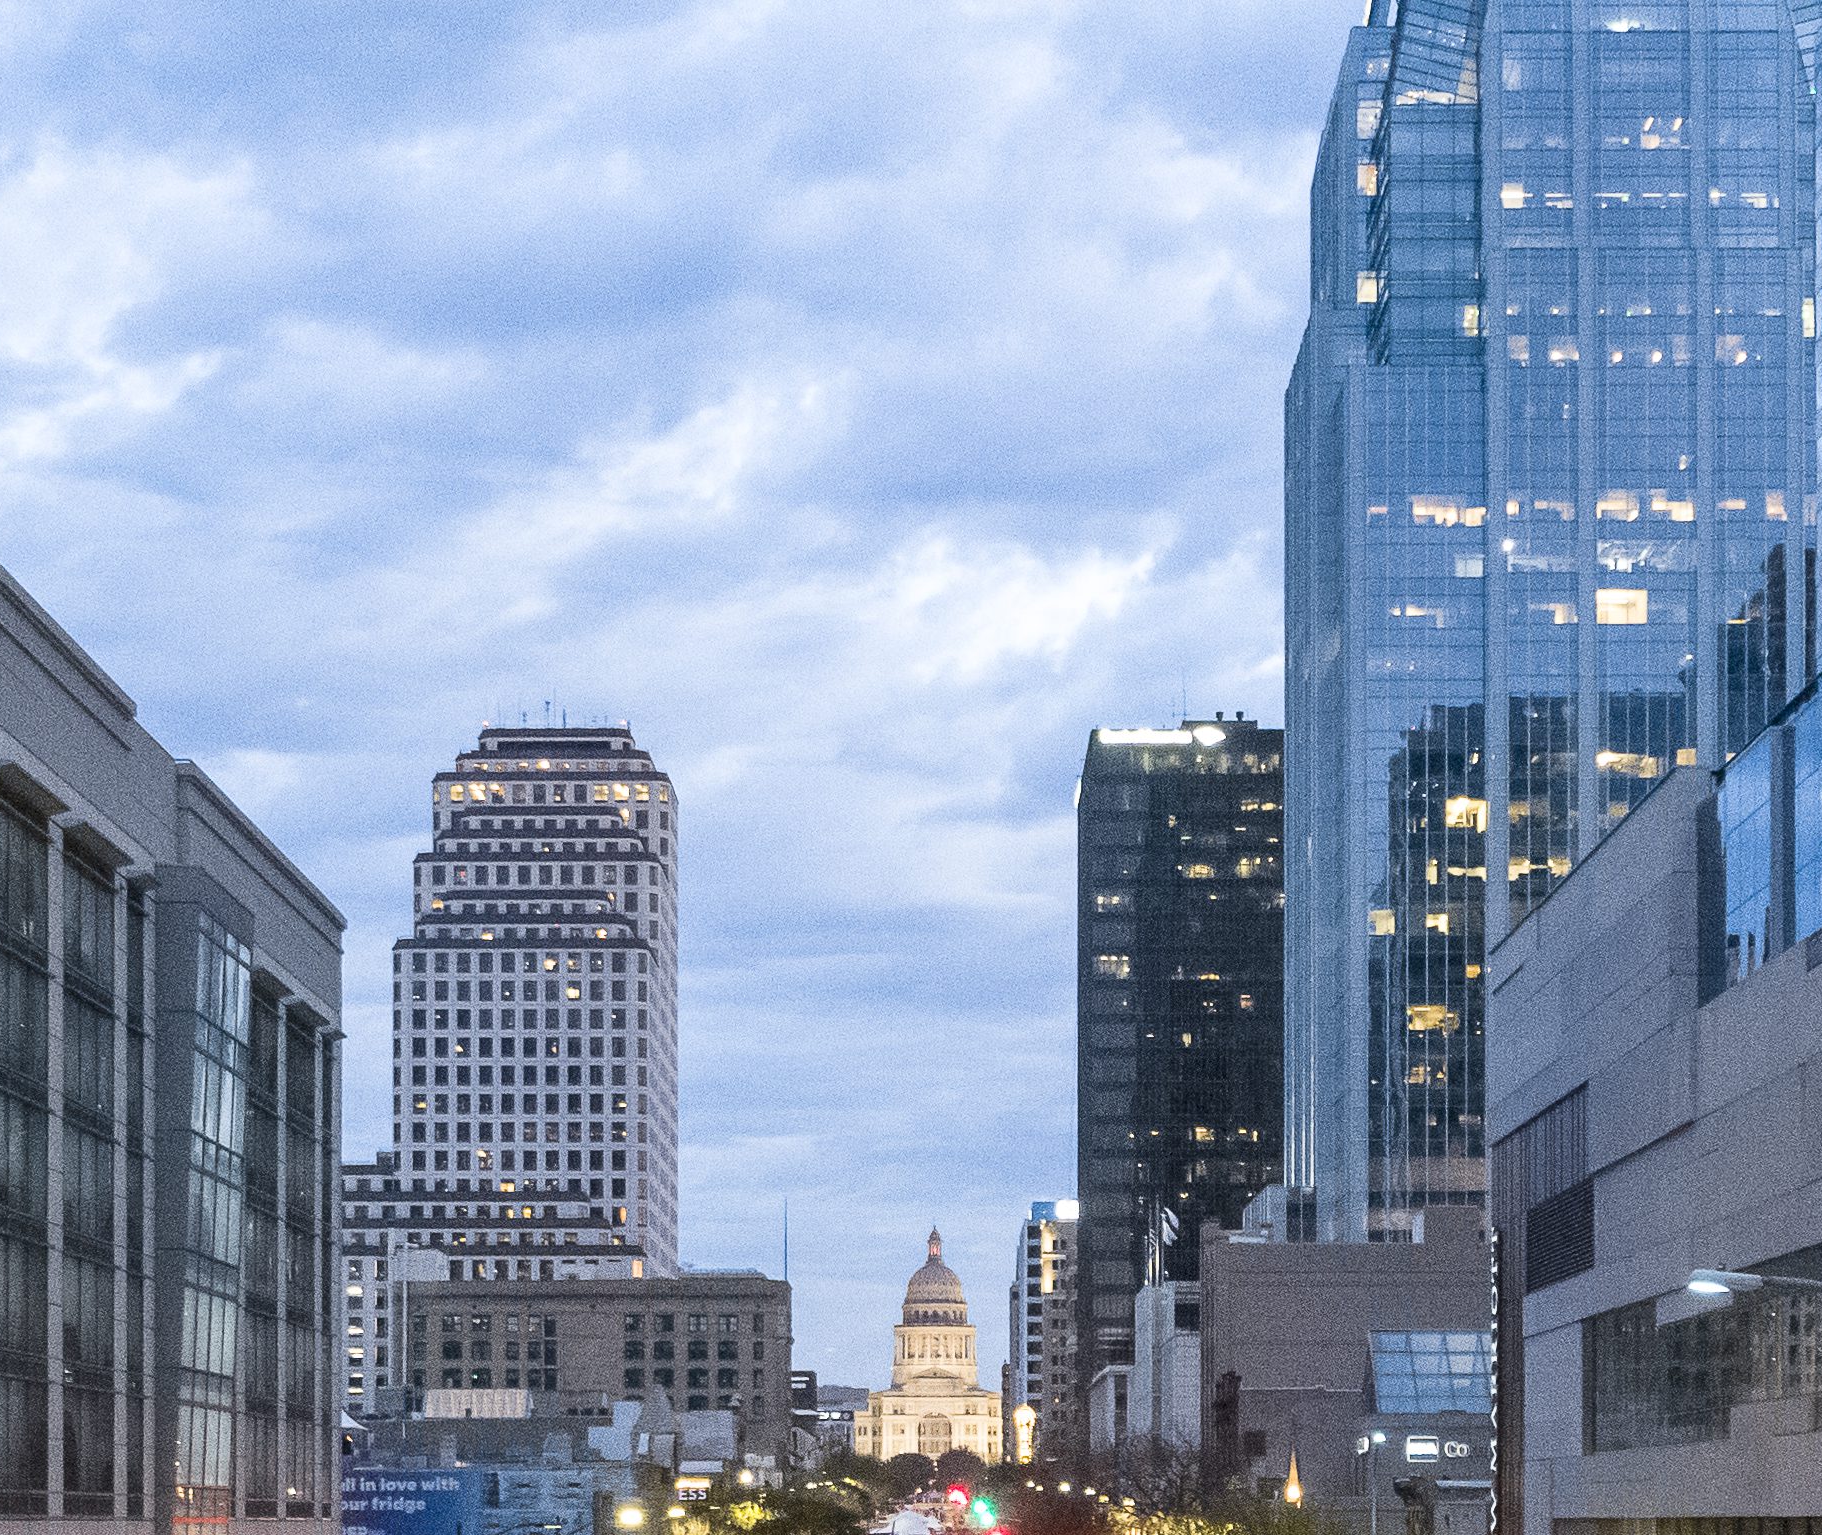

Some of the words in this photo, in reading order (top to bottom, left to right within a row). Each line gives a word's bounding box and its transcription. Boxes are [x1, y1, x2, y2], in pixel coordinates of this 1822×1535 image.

[379, 1477, 417, 1491] love
[421, 1477, 460, 1491] with
[372, 1496, 427, 1514] fridge
